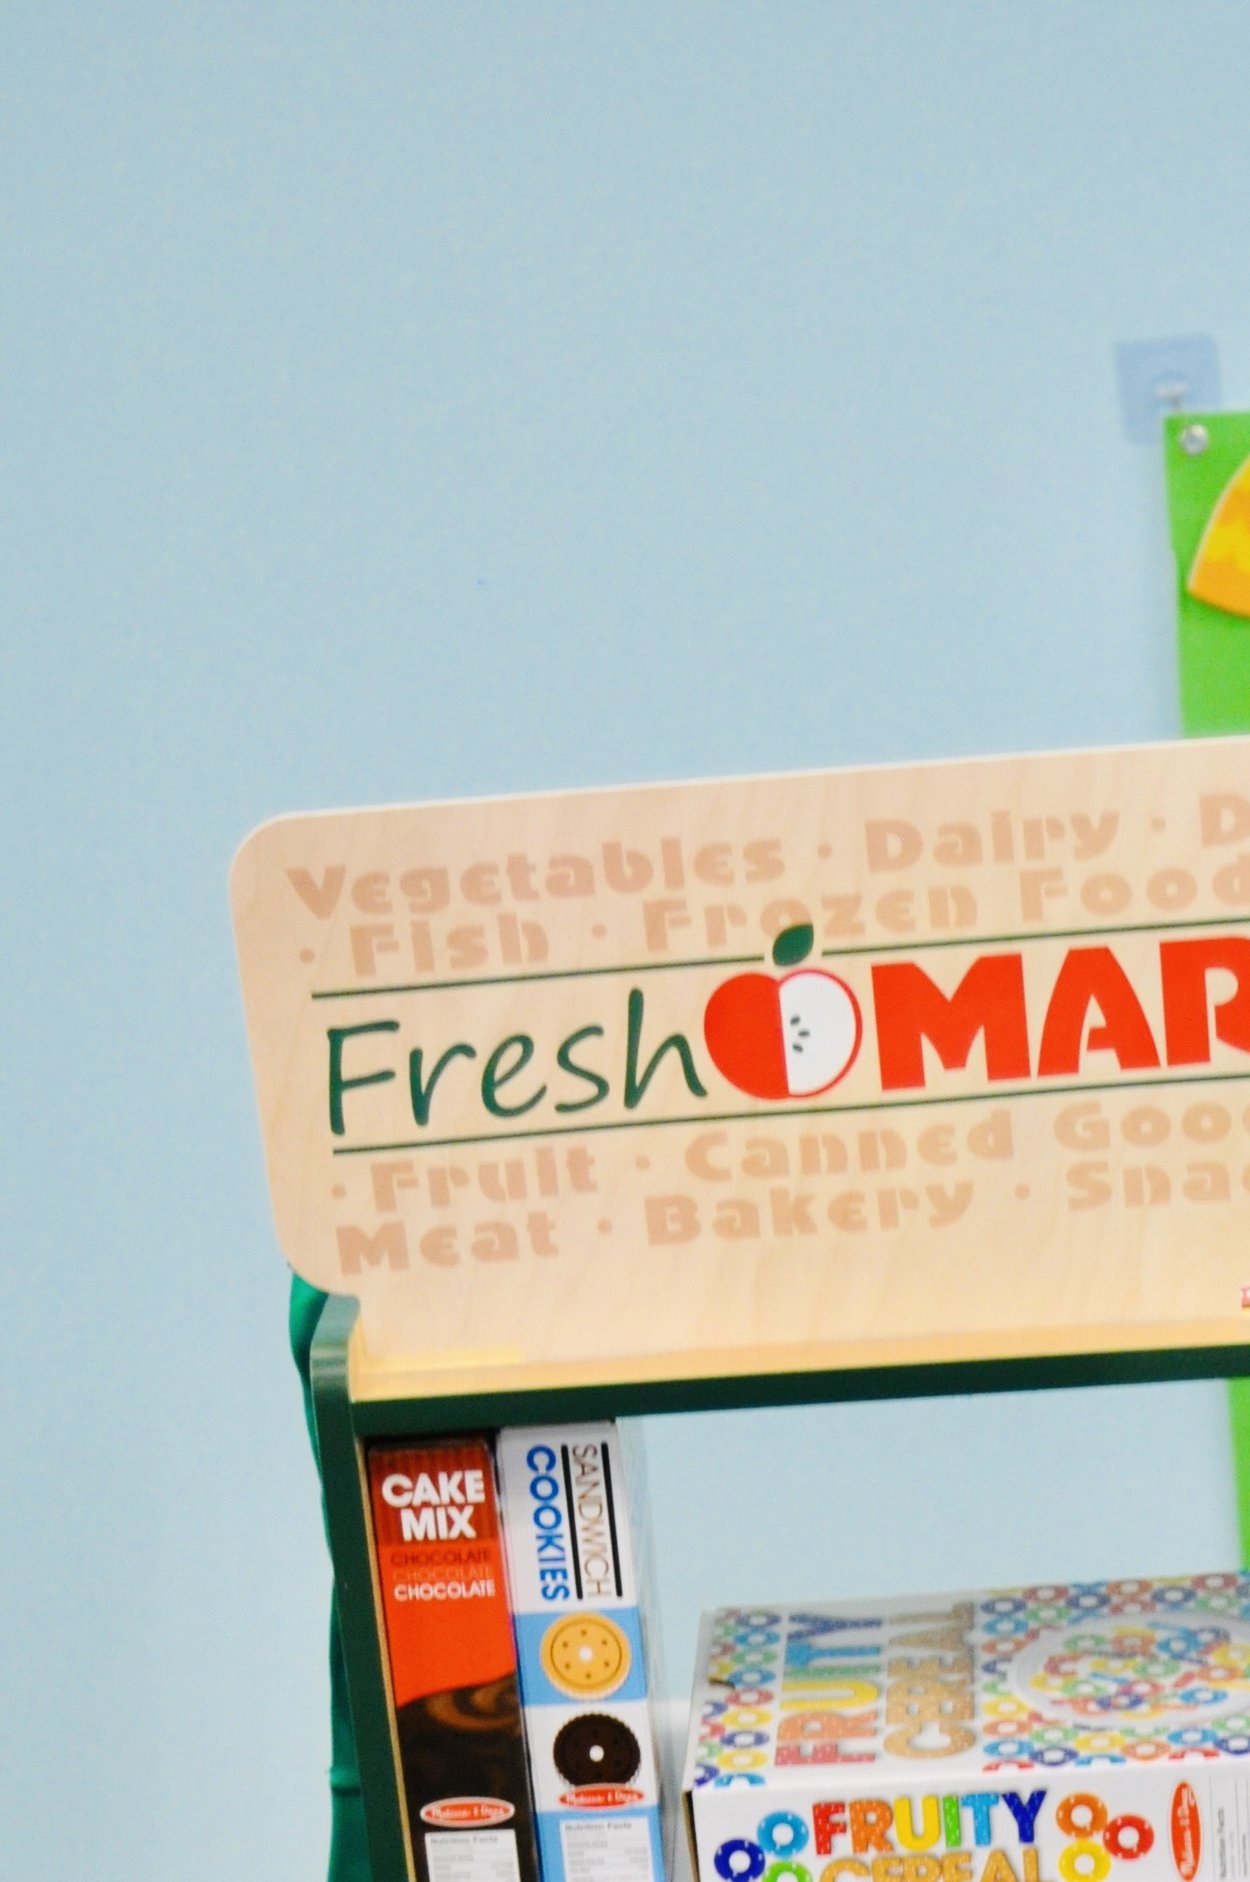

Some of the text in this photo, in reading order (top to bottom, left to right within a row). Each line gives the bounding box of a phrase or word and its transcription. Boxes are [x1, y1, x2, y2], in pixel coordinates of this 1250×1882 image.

[286, 836, 785, 920] Vegetables
[865, 809, 1120, 874] Dairy
[349, 912, 550, 978] Fish
[642, 884, 978, 953] Frozen
[327, 988, 708, 1136] Fresh
[370, 1145, 598, 1214] Fruit
[685, 1109, 1014, 1183] Canned
[335, 1210, 559, 1277] Meat
[644, 1180, 973, 1247] Bakery
[381, 1469, 486, 1510] CAKE
[400, 1506, 477, 1542] MIX
[526, 1444, 570, 1602] COOKIES
[571, 1443, 612, 1599] SANDWICH
[391, 1549, 491, 1566] CHOCOLATE
[394, 1580, 496, 1602] CHOCOLATE
[774, 1613, 882, 1767] FRUITY
[883, 1603, 977, 1759] CEREAL
[811, 1789, 1047, 1856] FRUITY
